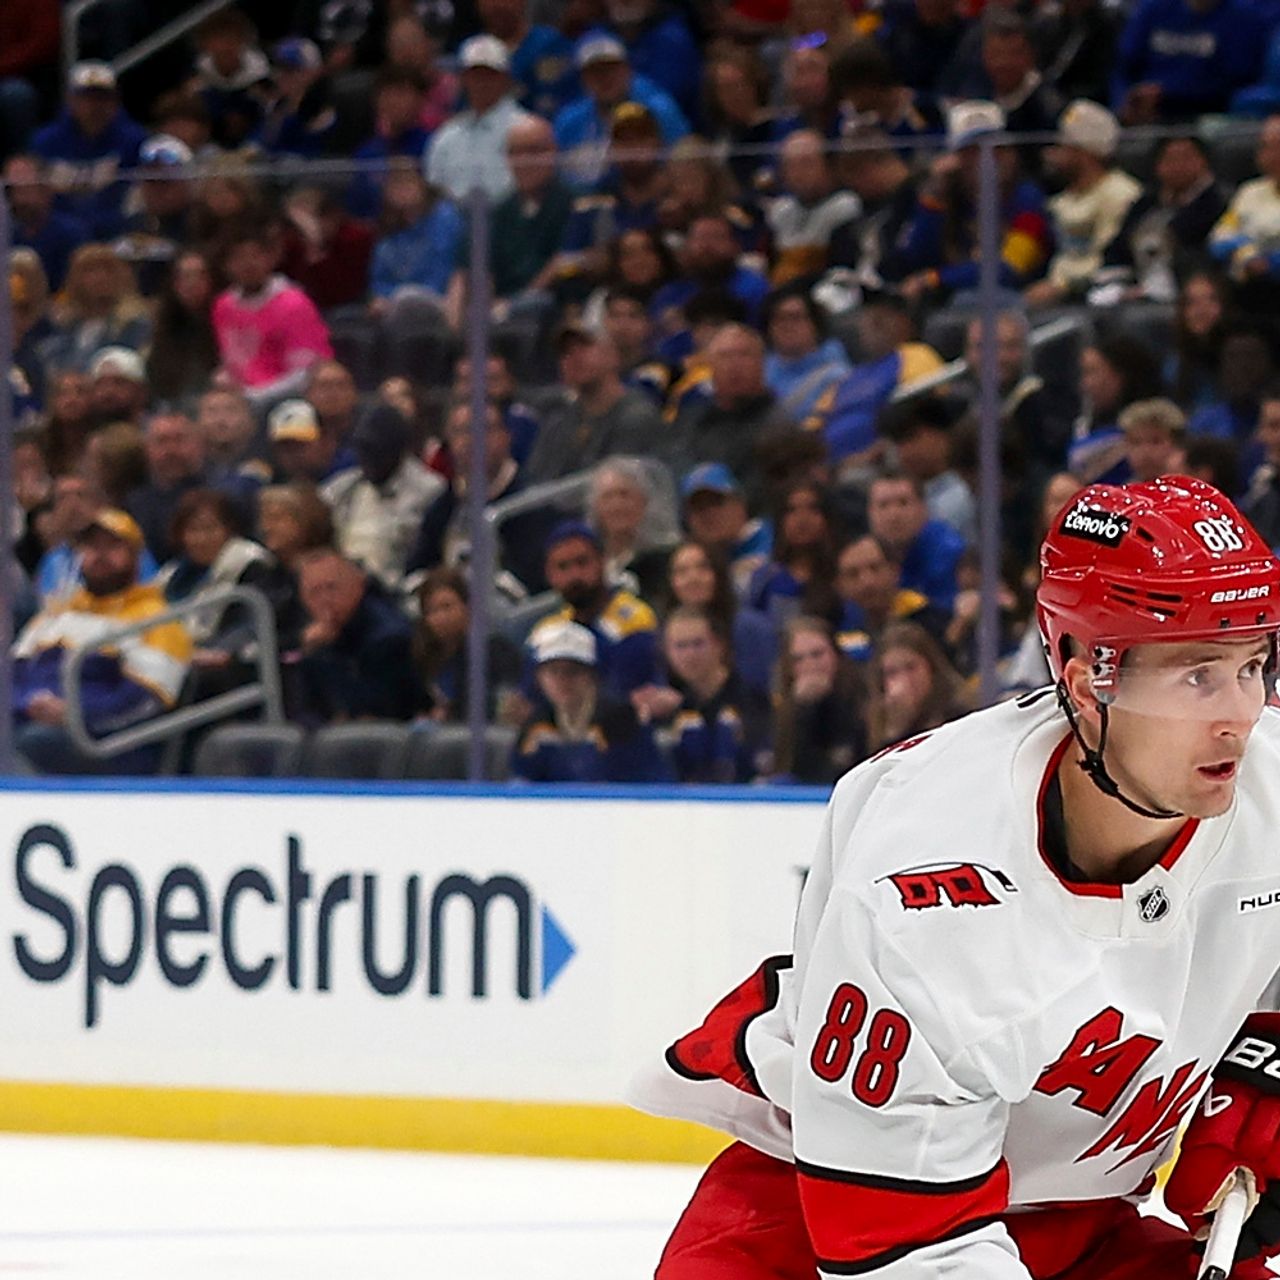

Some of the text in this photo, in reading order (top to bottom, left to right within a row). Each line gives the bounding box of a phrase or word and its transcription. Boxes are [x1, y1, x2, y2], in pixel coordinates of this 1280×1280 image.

[1194, 517, 1243, 552] 88
[13, 823, 532, 1029] Spectrum
[810, 982, 912, 1108] 88
